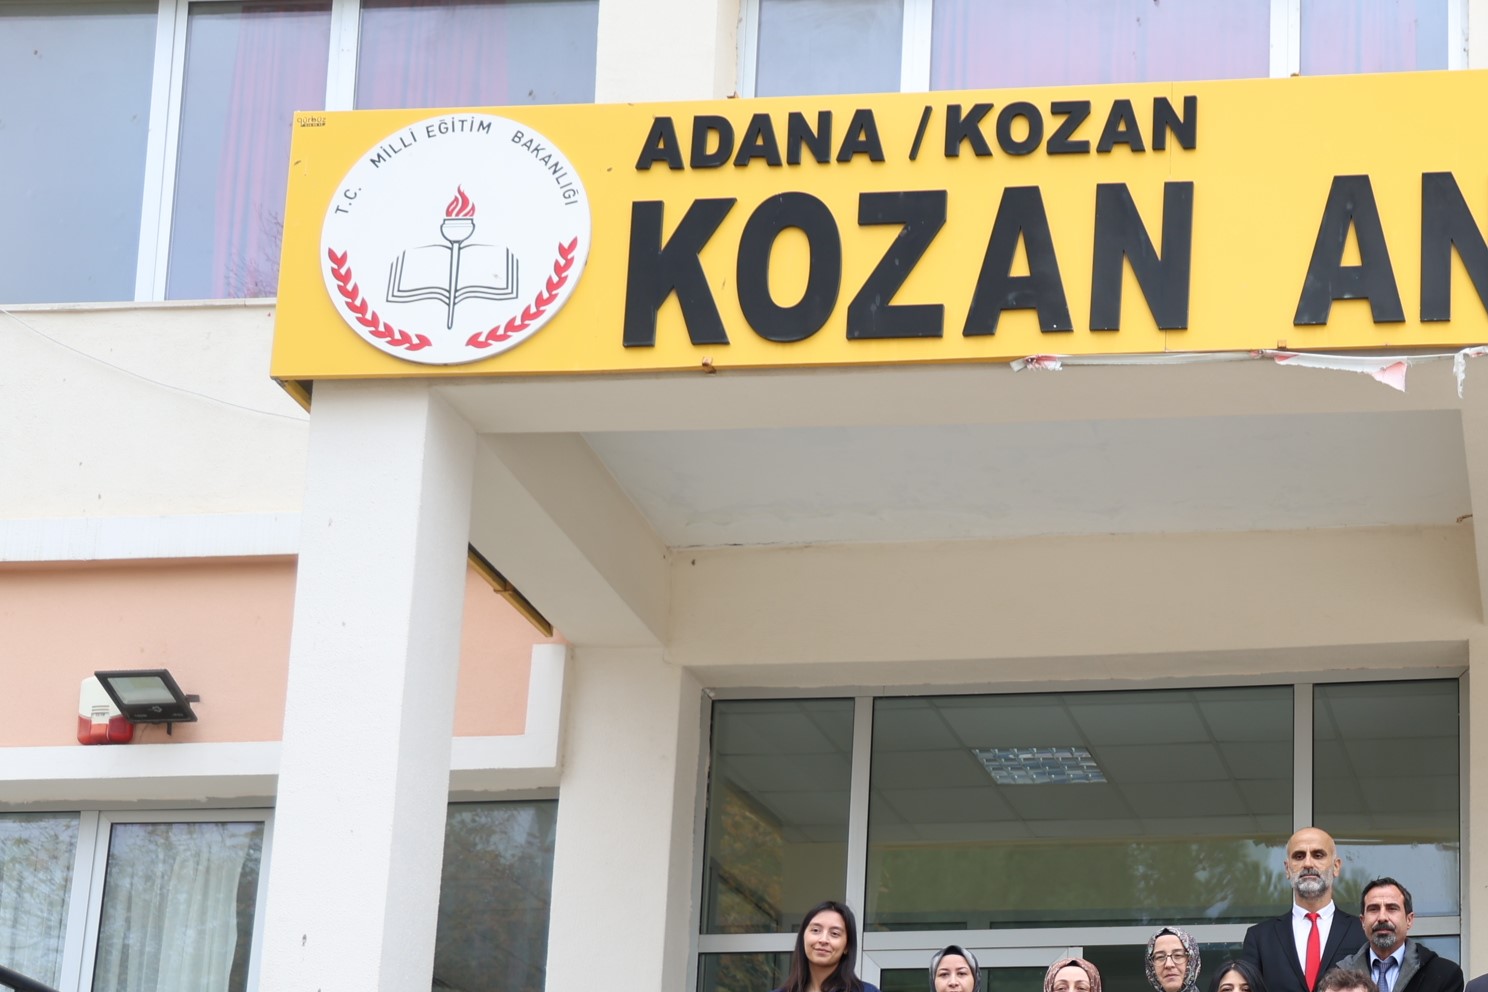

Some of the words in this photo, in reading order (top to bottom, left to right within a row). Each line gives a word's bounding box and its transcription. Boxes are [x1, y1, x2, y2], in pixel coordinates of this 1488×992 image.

[335, 186, 362, 215] T.C.
[369, 128, 418, 169] MİLLİ
[426, 116, 493, 139] EĞİTİM
[511, 129, 579, 207] BAKANLIĞI
[635, 107, 886, 170] ADANA
[622, 180, 1196, 348] KOZAN
